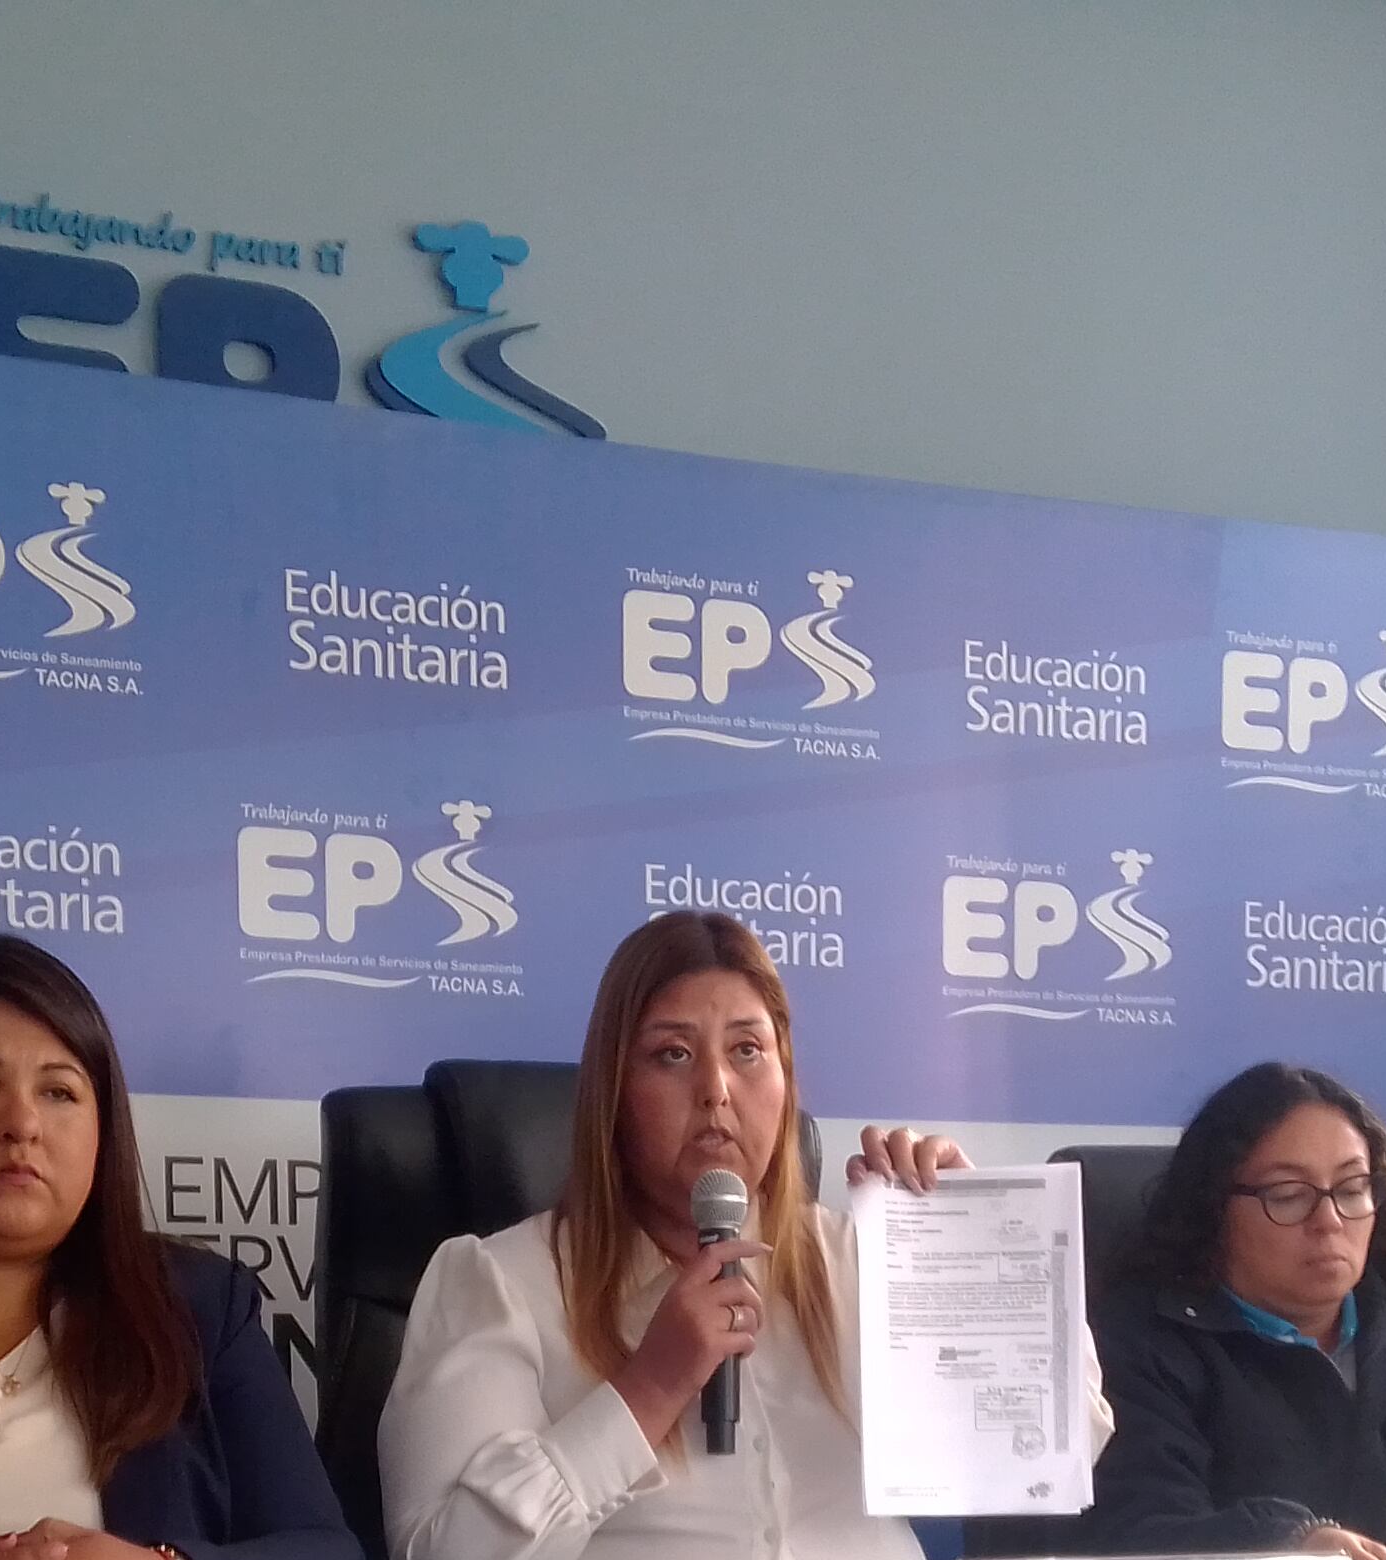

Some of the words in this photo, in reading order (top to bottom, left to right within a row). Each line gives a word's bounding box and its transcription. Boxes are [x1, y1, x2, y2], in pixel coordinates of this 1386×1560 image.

[212, 230, 300, 271] para
[316, 239, 347, 275] ti
[626, 567, 705, 590] Trabajando
[710, 579, 742, 596] para
[748, 581, 759, 596] ti
[283, 568, 506, 634] Educación
[41, 651, 57, 664] de
[61, 653, 142, 672] Saneamiento
[289, 620, 508, 690] Sanitaria
[964, 639, 1147, 695] Educación
[35, 668, 102, 692] TACNA
[108, 676, 143, 696] S.A.
[965, 686, 1149, 745] Sanitaria
[794, 737, 847, 757] TACNA
[851, 743, 880, 760] S.A.
[241, 803, 328, 825] Trabajando
[333, 812, 369, 830] para
[375, 814, 388, 830] ti
[645, 864, 842, 916] Educación
[239, 948, 292, 963] Empresa
[295, 951, 359, 967] Prestadora
[362, 956, 376, 966] de
[379, 956, 431, 970] Servicios
[434, 960, 448, 972] de
[428, 976, 487, 994] TACNA
[493, 980, 525, 996] S.A.
[1097, 1008, 1145, 1024] TACNA
[165, 1156, 321, 1225] EMP
